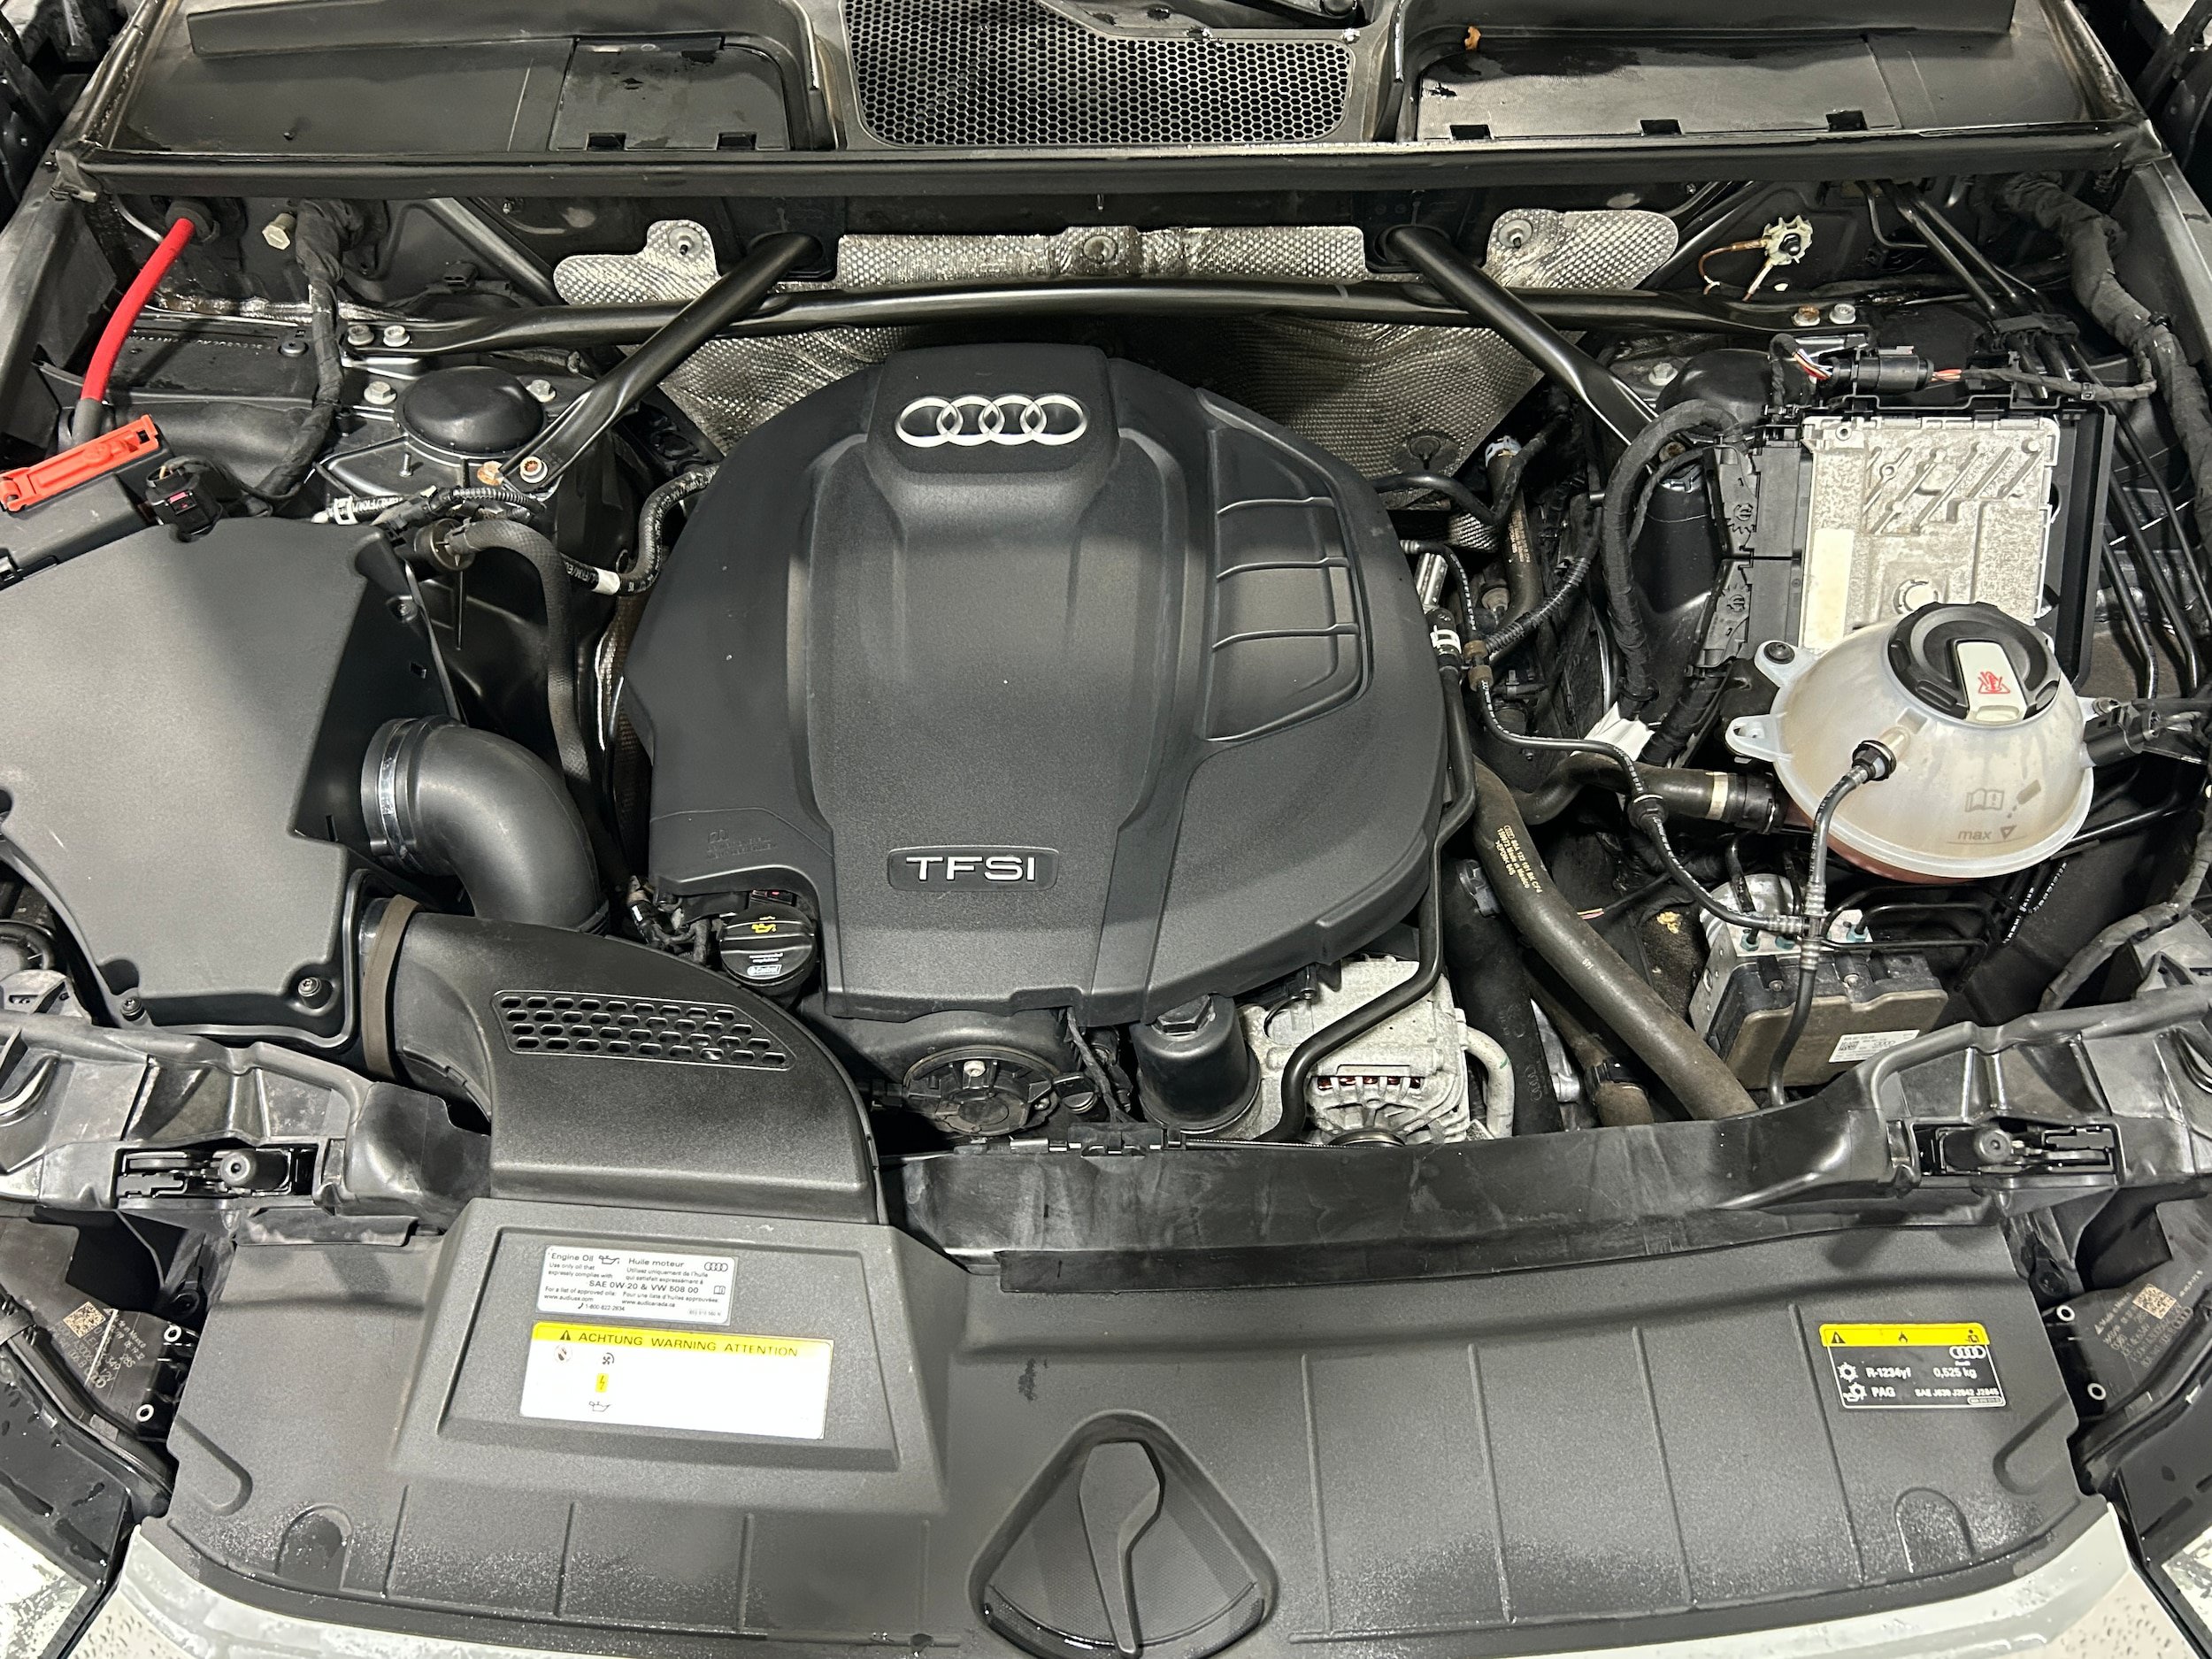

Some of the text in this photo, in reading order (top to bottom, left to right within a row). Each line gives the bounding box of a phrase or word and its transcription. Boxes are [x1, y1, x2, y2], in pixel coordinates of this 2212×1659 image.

[1957, 830, 1993, 840] max
[906, 856, 1035, 881] TFSI
[1516, 868, 1530, 889] Mexico
[551, 1253, 580, 1262] Engine
[588, 1279, 608, 1288] SAE
[579, 1333, 798, 1356] ACHTUNG WARNING ATTENTION
[1866, 1367, 1978, 1380] R-1234yf 0,525 kg
[1870, 1386, 1896, 1398] PAG
[1914, 1388, 1932, 1397] SAE
